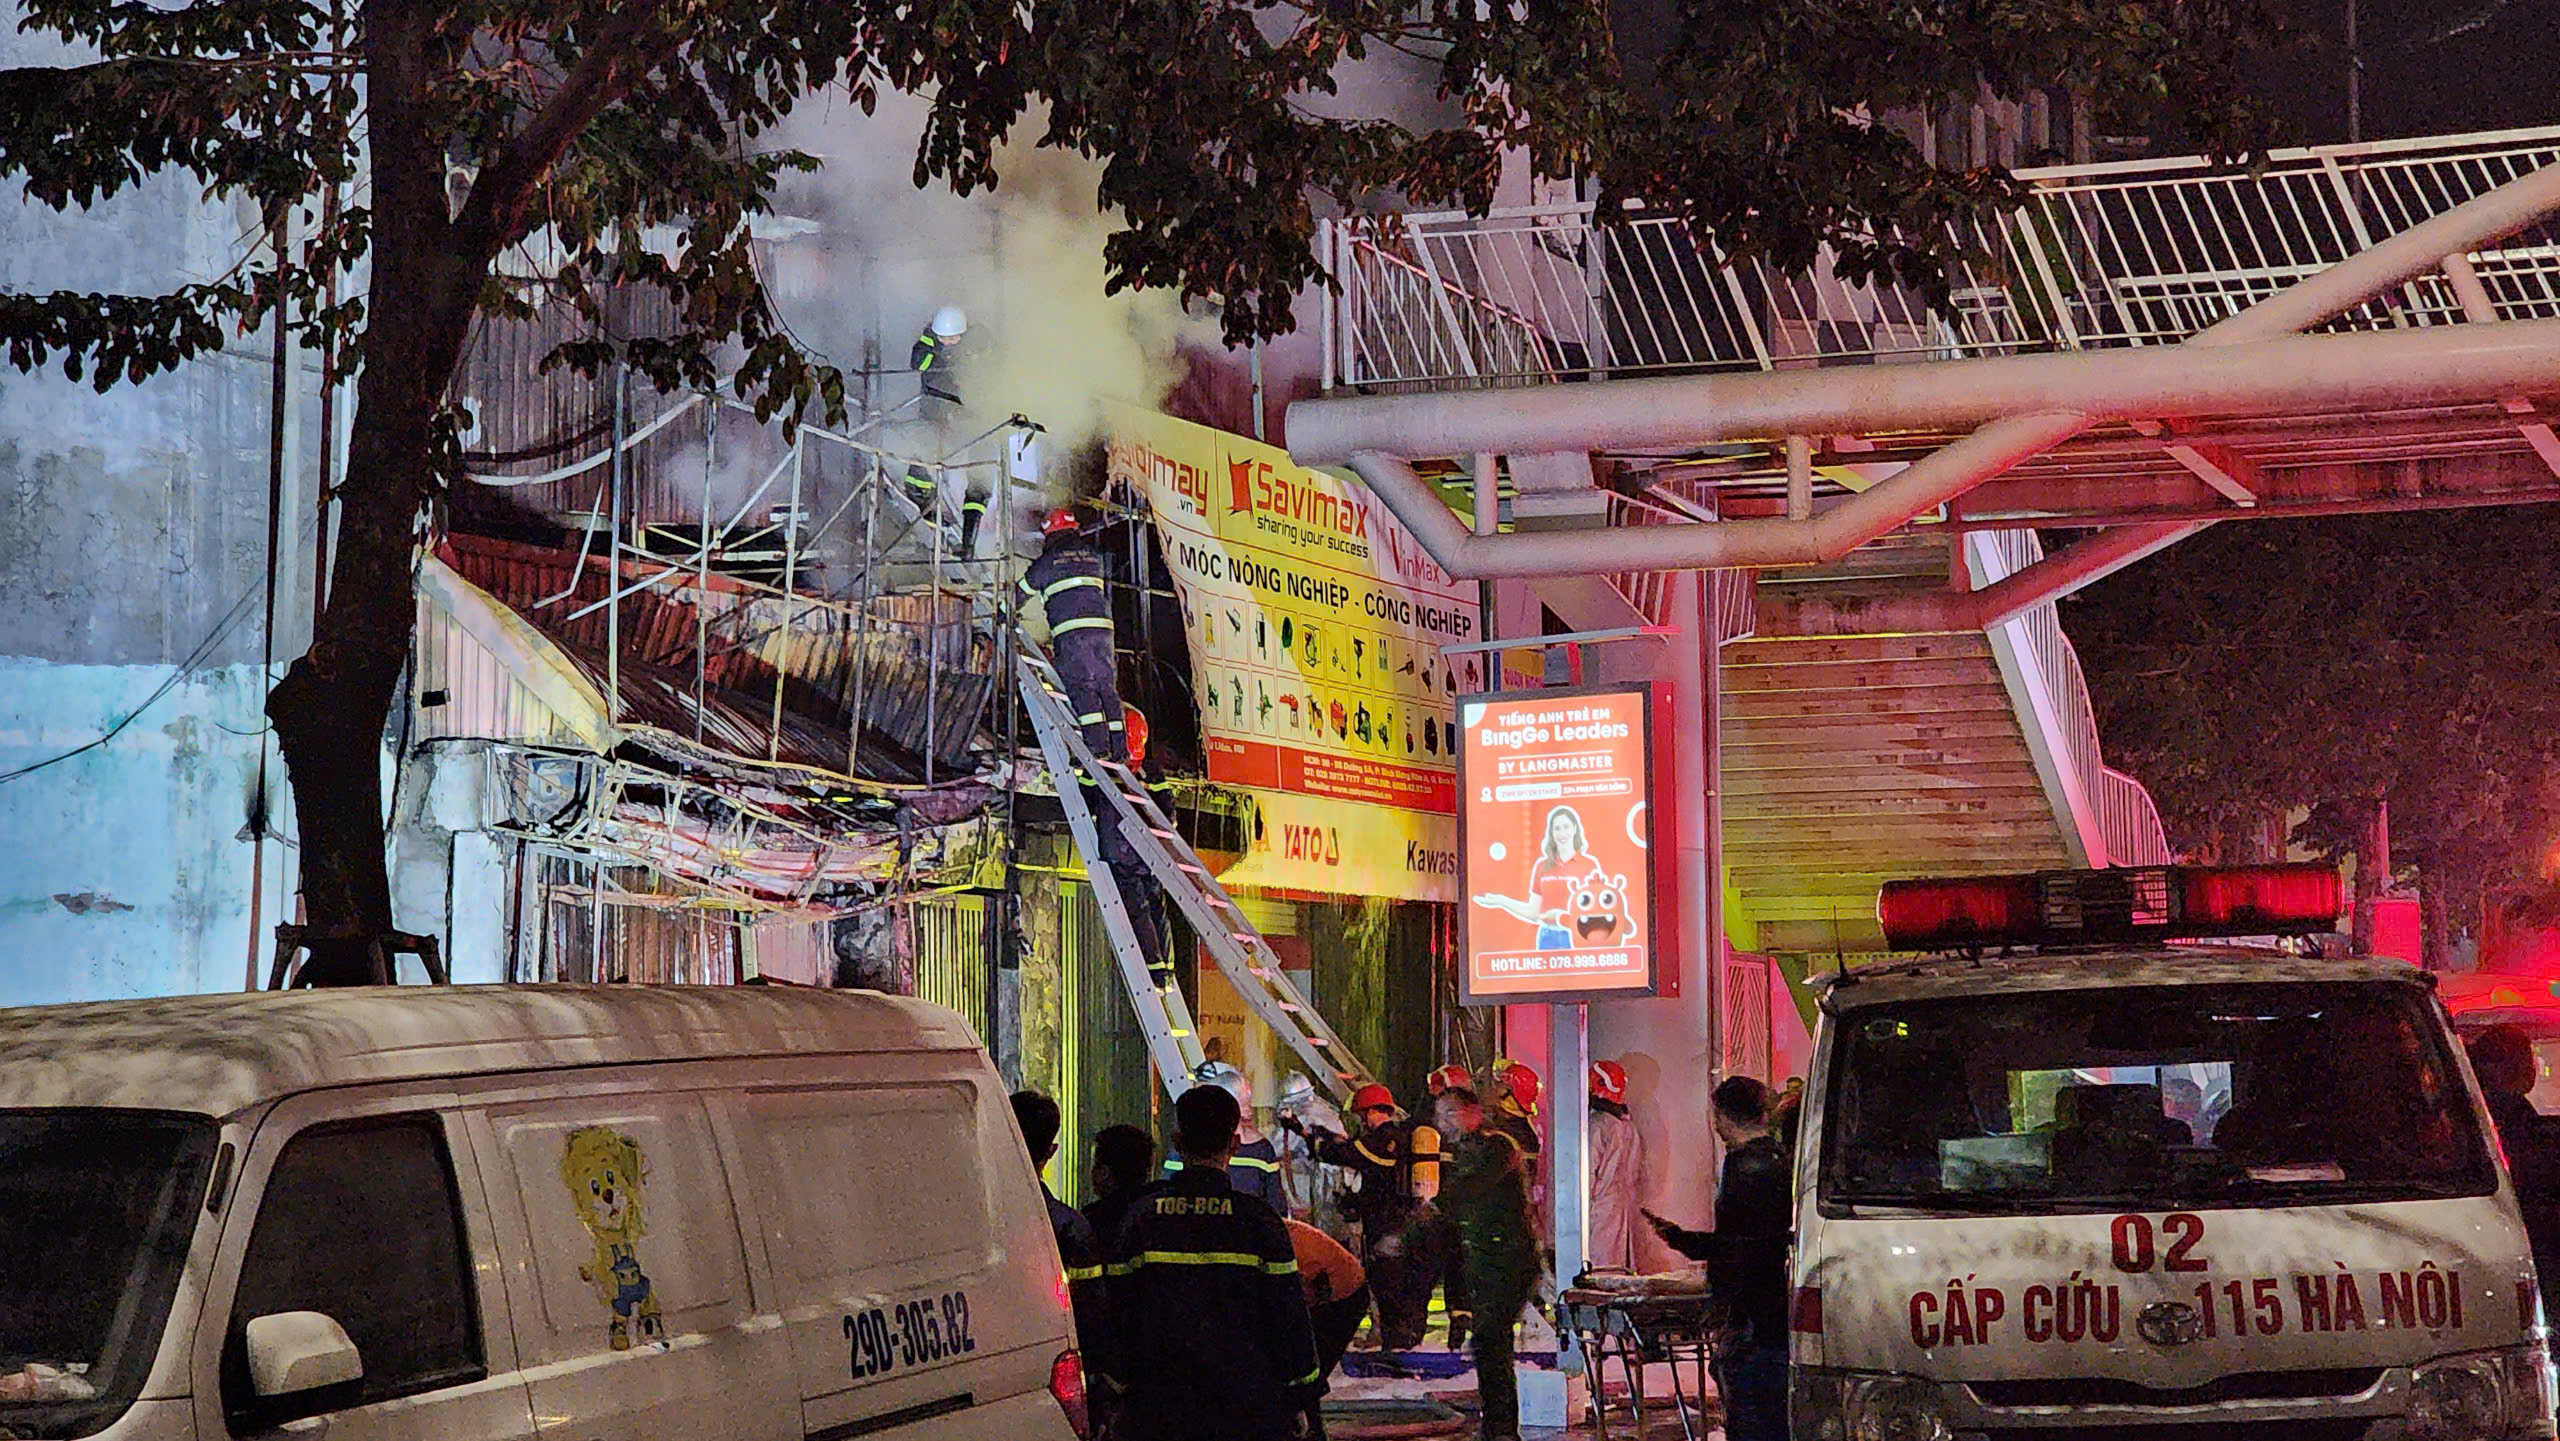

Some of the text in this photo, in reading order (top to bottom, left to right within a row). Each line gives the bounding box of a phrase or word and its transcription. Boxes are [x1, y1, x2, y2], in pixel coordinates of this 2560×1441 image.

[1256, 462, 1369, 540] Savimax
[1256, 514, 1369, 559] sharing your success
[1389, 527, 1441, 585] VinMax
[1179, 543, 1222, 579] MÓC
[1227, 553, 1281, 593] NÔNG
[1287, 571, 1349, 615] NGHIỆP
[1364, 588, 1411, 625] CÔNG
[1415, 603, 1472, 644] NGHIỆP
[1481, 721, 1629, 750] BingGo Leaders
[1498, 706, 1611, 727] TIẾNG ANH TRẺ EM
[1498, 755, 1613, 775] BY LANGMASTER
[1283, 823, 1322, 863] YATO
[1490, 957, 1547, 973] HOTLINE:
[2110, 1212, 2209, 1274] 02
[1908, 1259, 2464, 1349] CẤP CỨU 115 HÀ NỘI
[843, 1290, 976, 1380] 29D-305.82
